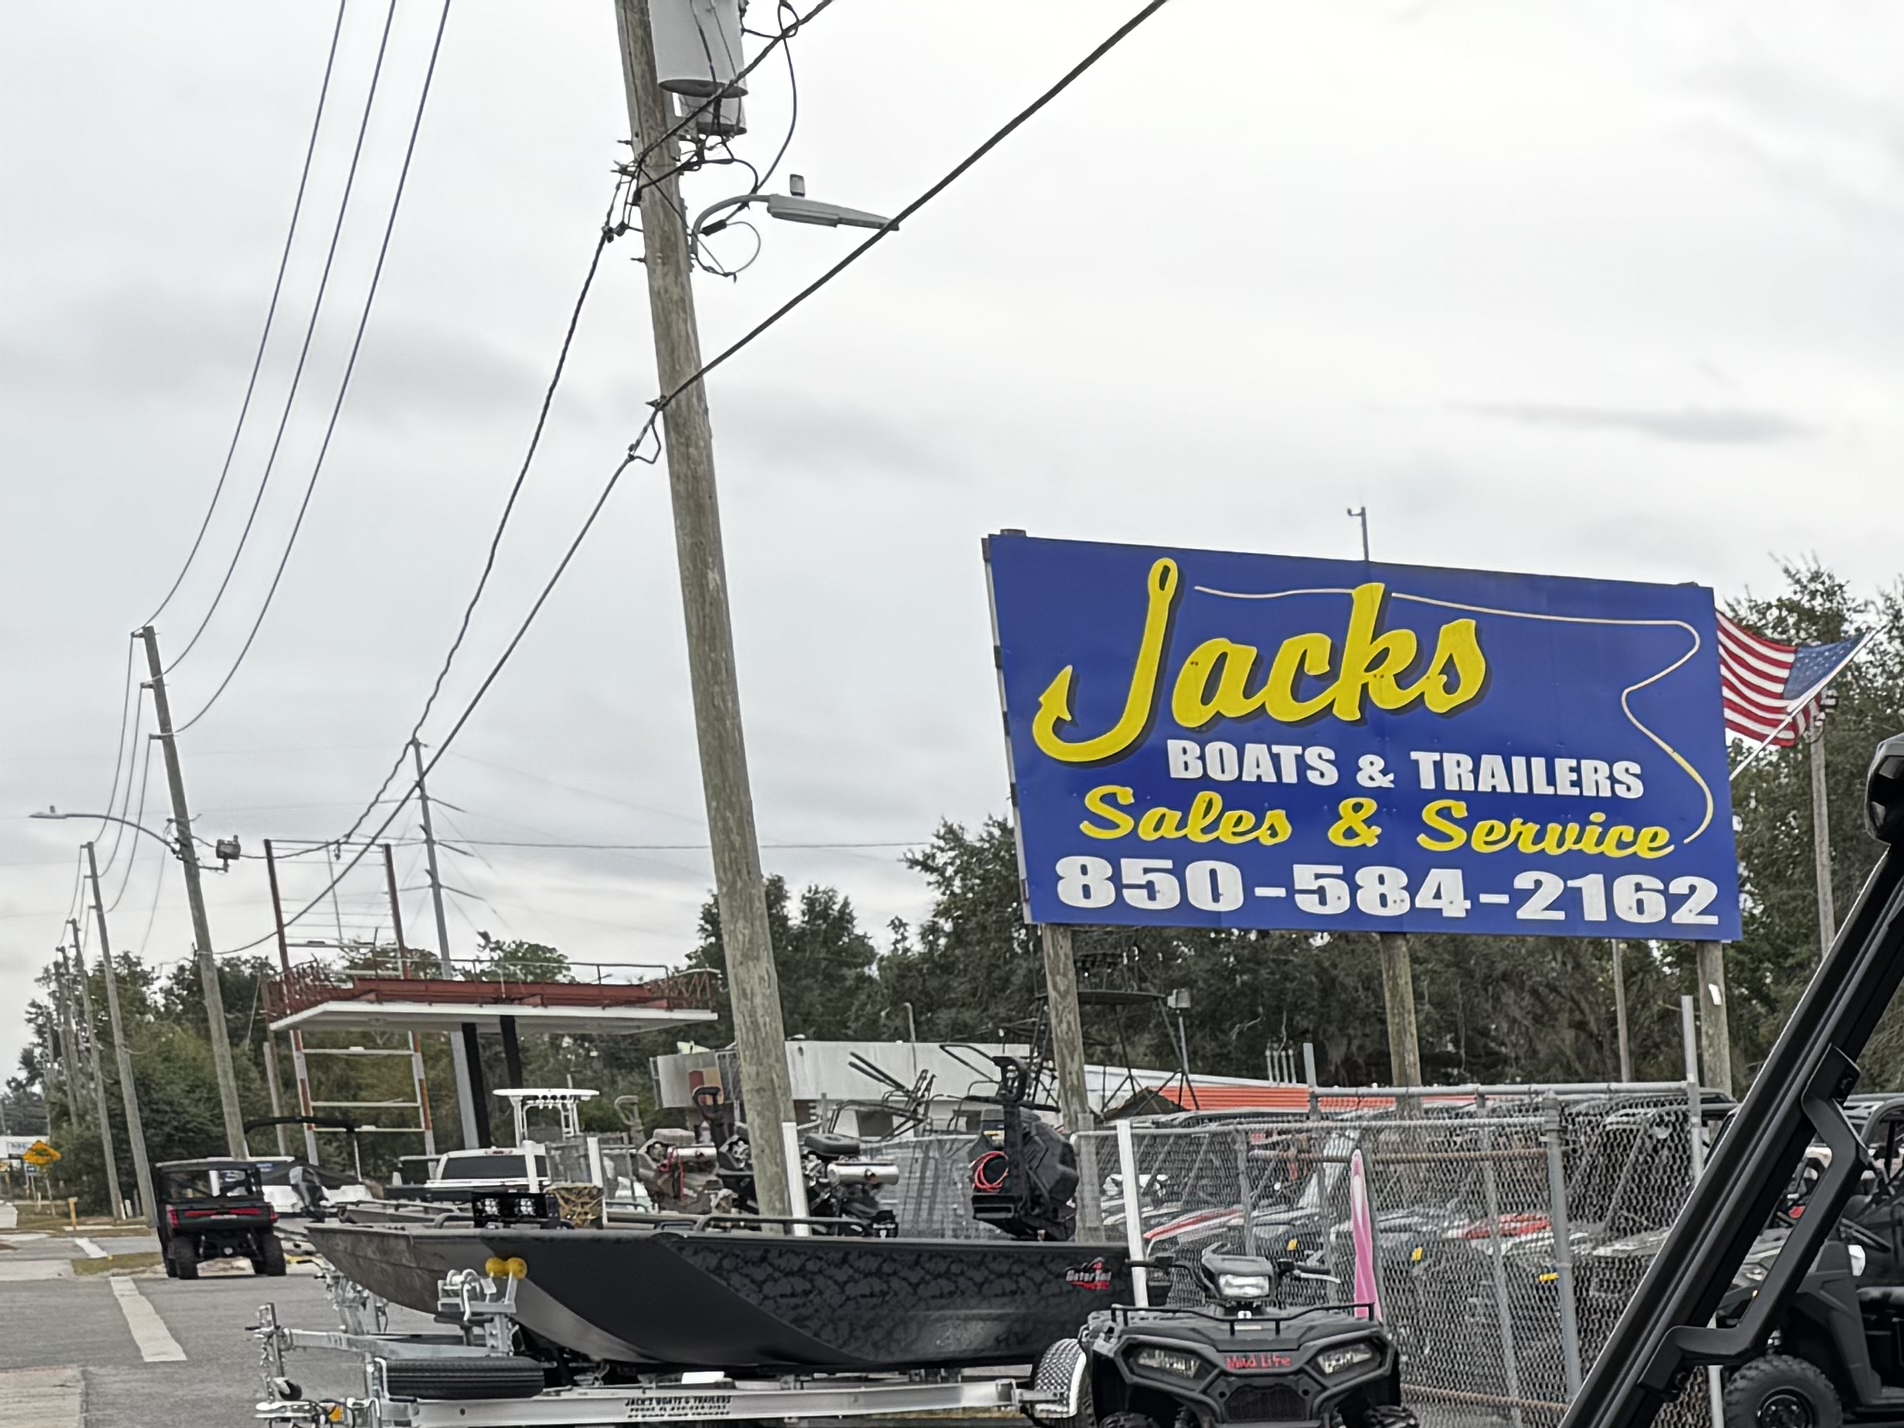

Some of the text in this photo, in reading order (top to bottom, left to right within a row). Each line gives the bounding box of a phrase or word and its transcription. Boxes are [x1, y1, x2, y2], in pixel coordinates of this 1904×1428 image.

[1032, 558, 1487, 763] Jacks
[1167, 739, 1644, 799] BOATS & TRAILERS
[1080, 785, 1674, 859] Sales & Service
[1055, 855, 1720, 926] 850-584-2162
